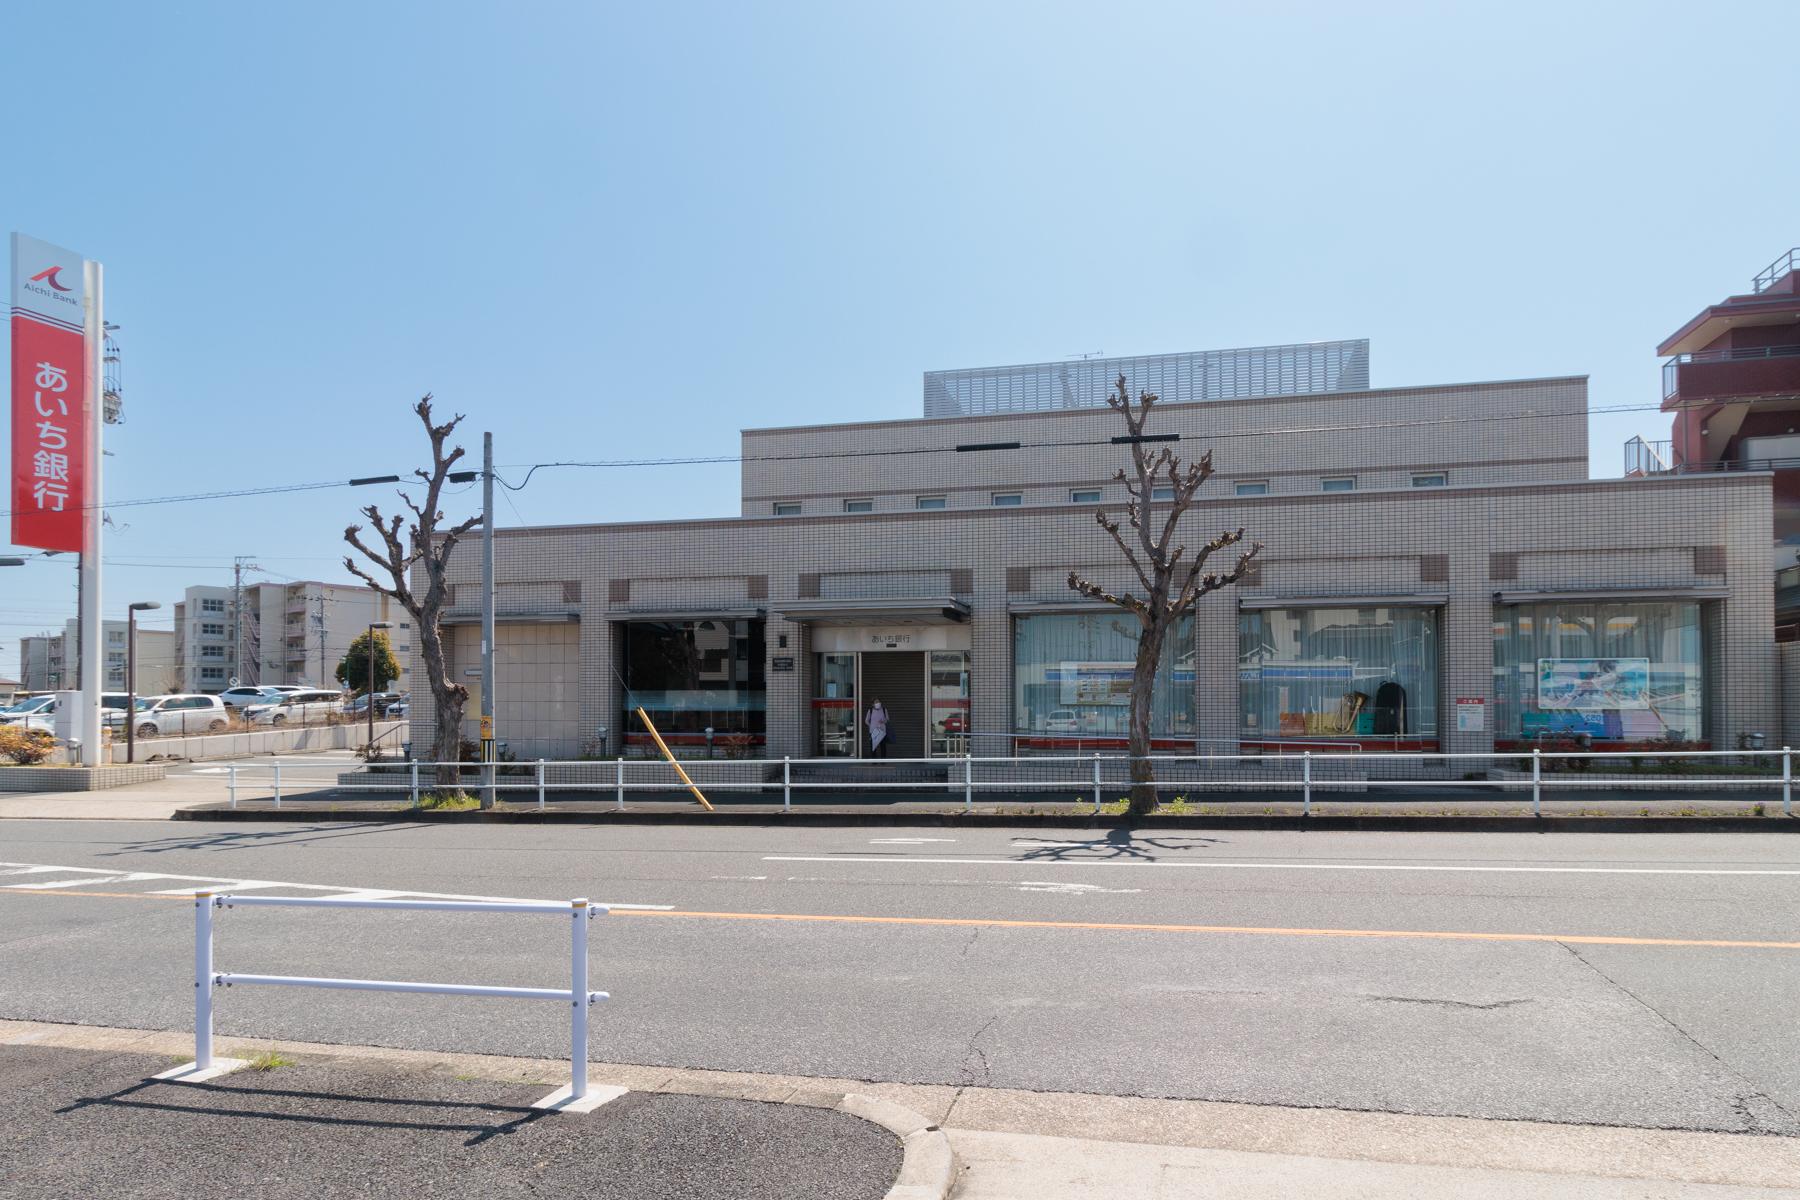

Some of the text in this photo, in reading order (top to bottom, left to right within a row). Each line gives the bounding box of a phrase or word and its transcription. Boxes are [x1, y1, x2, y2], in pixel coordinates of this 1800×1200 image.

[23, 282, 78, 306] Aichi Bank
[34, 361, 69, 512] あいち銀行
[871, 634, 911, 643] あいち銀行
